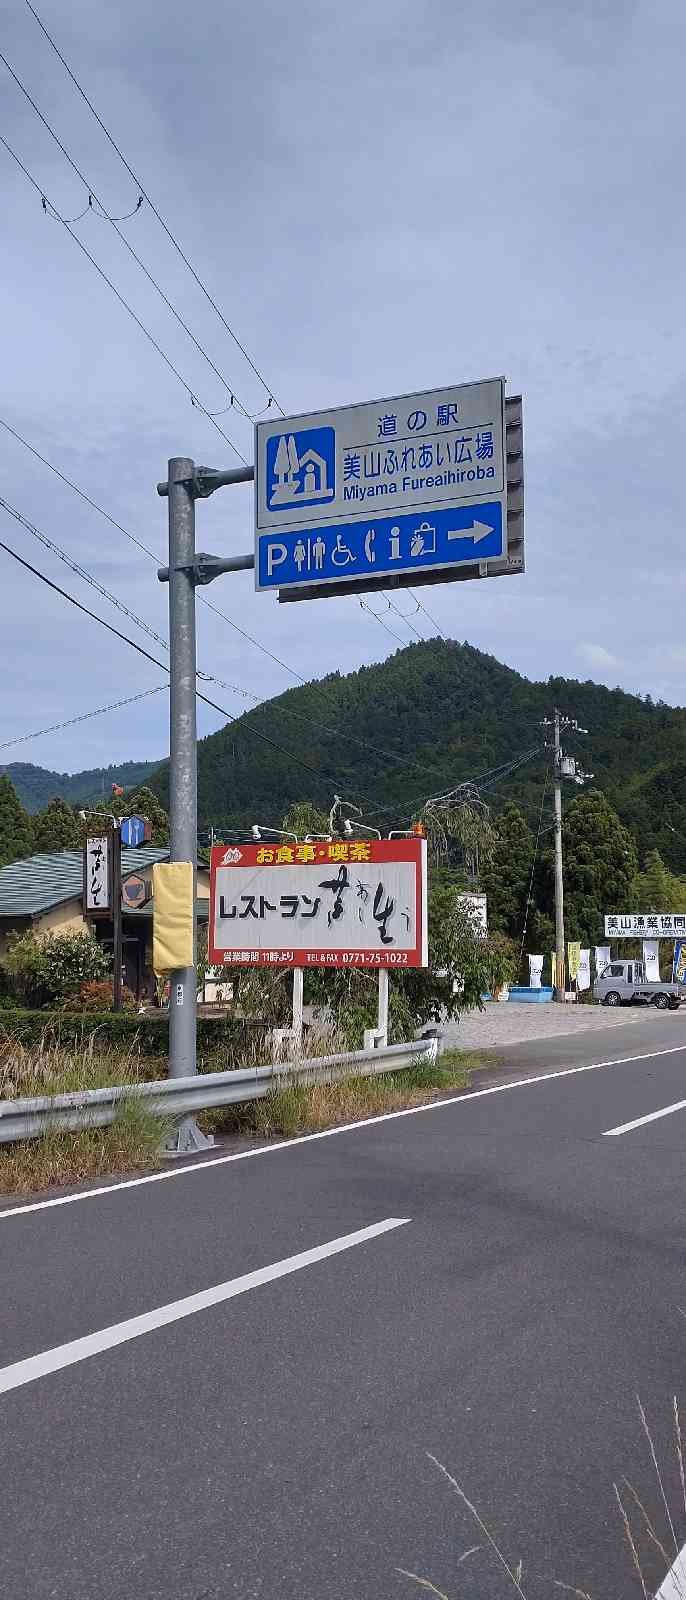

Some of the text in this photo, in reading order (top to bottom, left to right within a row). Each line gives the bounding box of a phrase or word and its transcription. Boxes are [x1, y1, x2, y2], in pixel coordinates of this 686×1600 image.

[378, 403, 458, 437] 道の駅
[343, 431, 494, 481] 美山ふれあい広場
[343, 464, 495, 501] Miyama Fureaihiroba
[267, 543, 288, 576] P
[256, 842, 371, 864] お食事・喫茶
[219, 894, 321, 919] レストラン
[607, 916, 686, 929] 美山漁業協同
[223, 951, 294, 962] 営業時間 11時より
[342, 952, 408, 963] 0771-75-1022
